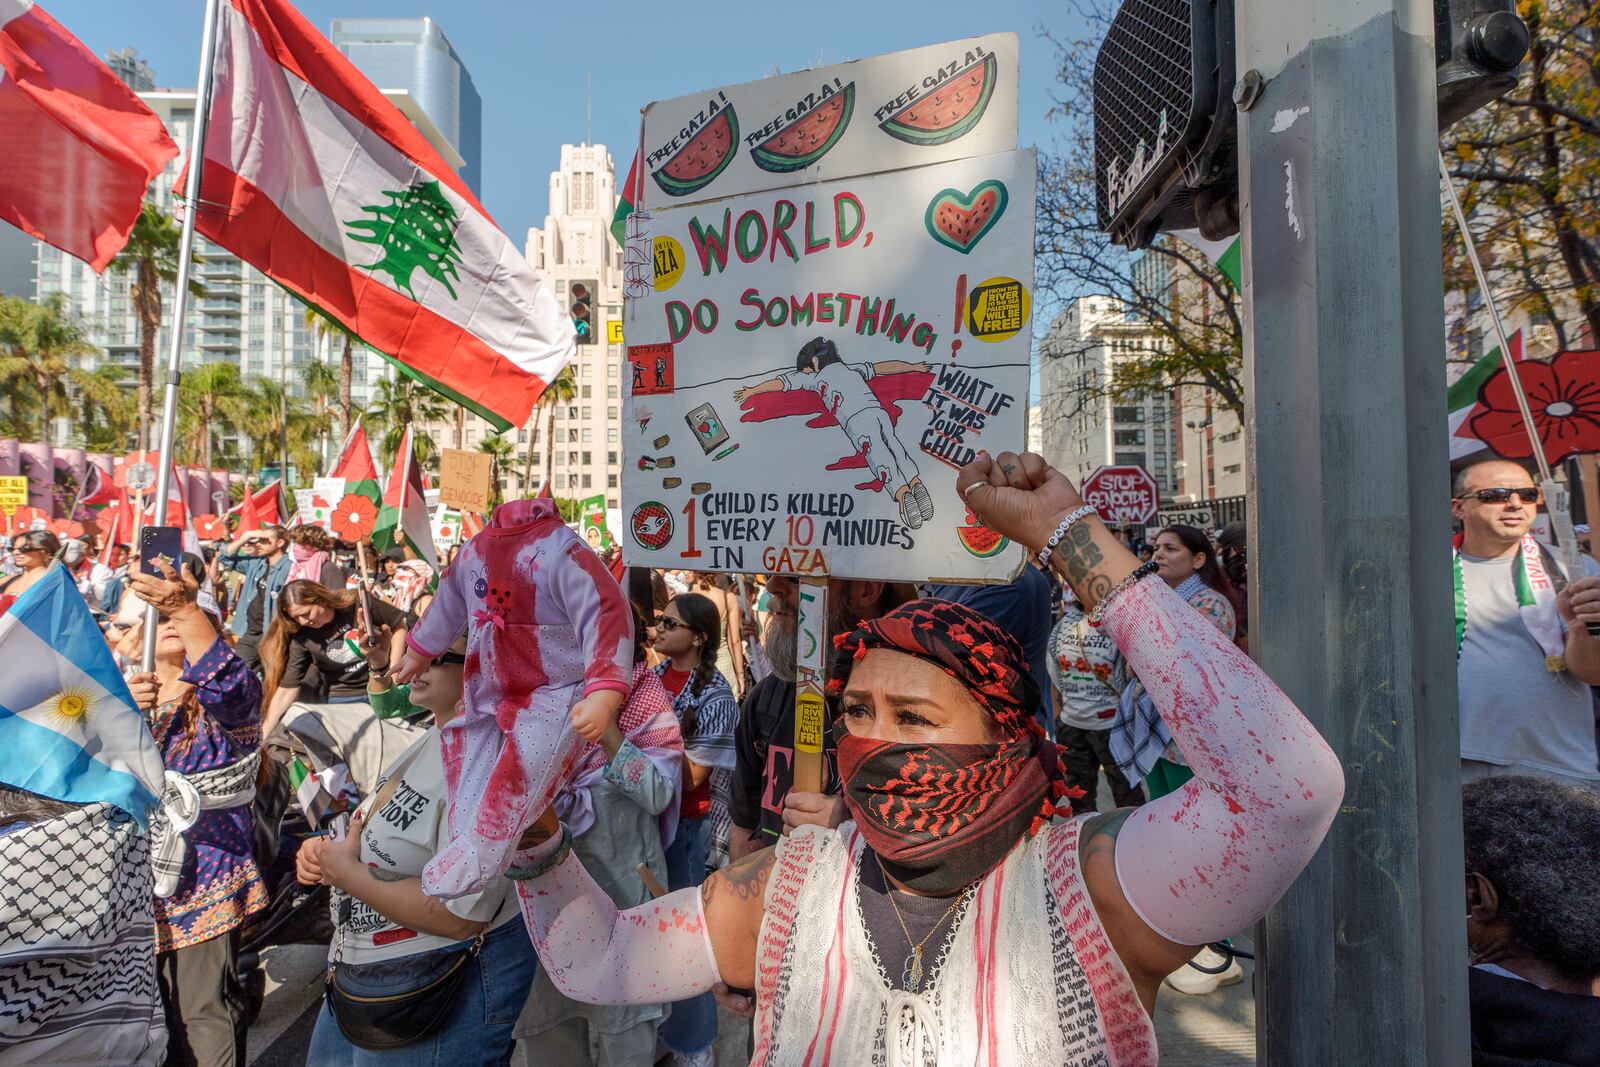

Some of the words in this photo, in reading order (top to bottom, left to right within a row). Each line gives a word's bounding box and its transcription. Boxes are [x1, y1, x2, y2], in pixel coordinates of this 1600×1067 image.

[874, 84, 920, 121] FREE
[744, 115, 784, 146] FREE
[646, 135, 681, 169] FREE
[688, 192, 874, 276] WORLD,
[988, 287, 1006, 295] FROM
[989, 291, 1018, 302] RIVER
[665, 298, 719, 343] DO
[984, 318, 1019, 332] FREE
[987, 310, 1006, 320] WILL
[1008, 309, 1019, 318] BE
[937, 364, 994, 406] WHAT
[985, 392, 1015, 416] IF
[922, 387, 950, 408] IT
[949, 403, 986, 429] WAS
[928, 409, 966, 444] YOUR
[920, 428, 975, 467] CHILD
[451, 453, 480, 470] STOP
[456, 472, 472, 482] THE
[1100, 475, 1144, 490] STOP
[441, 486, 483, 508] GENOCIDE
[1087, 490, 1150, 509] GENOCIDE
[680, 498, 702, 557] 1
[702, 492, 755, 516] CHILD
[760, 493, 779, 513] IS
[787, 493, 854, 517] KILLED
[1107, 506, 1147, 525] NOW
[1159, 512, 1211, 528] DEFUND
[707, 518, 776, 541] EVERY
[786, 515, 814, 546] 10
[822, 519, 914, 550] MINUTES
[708, 546, 743, 569] IN
[762, 546, 828, 573] GAZA
[802, 726, 819, 734] WILL
[369, 840, 397, 866] Question
